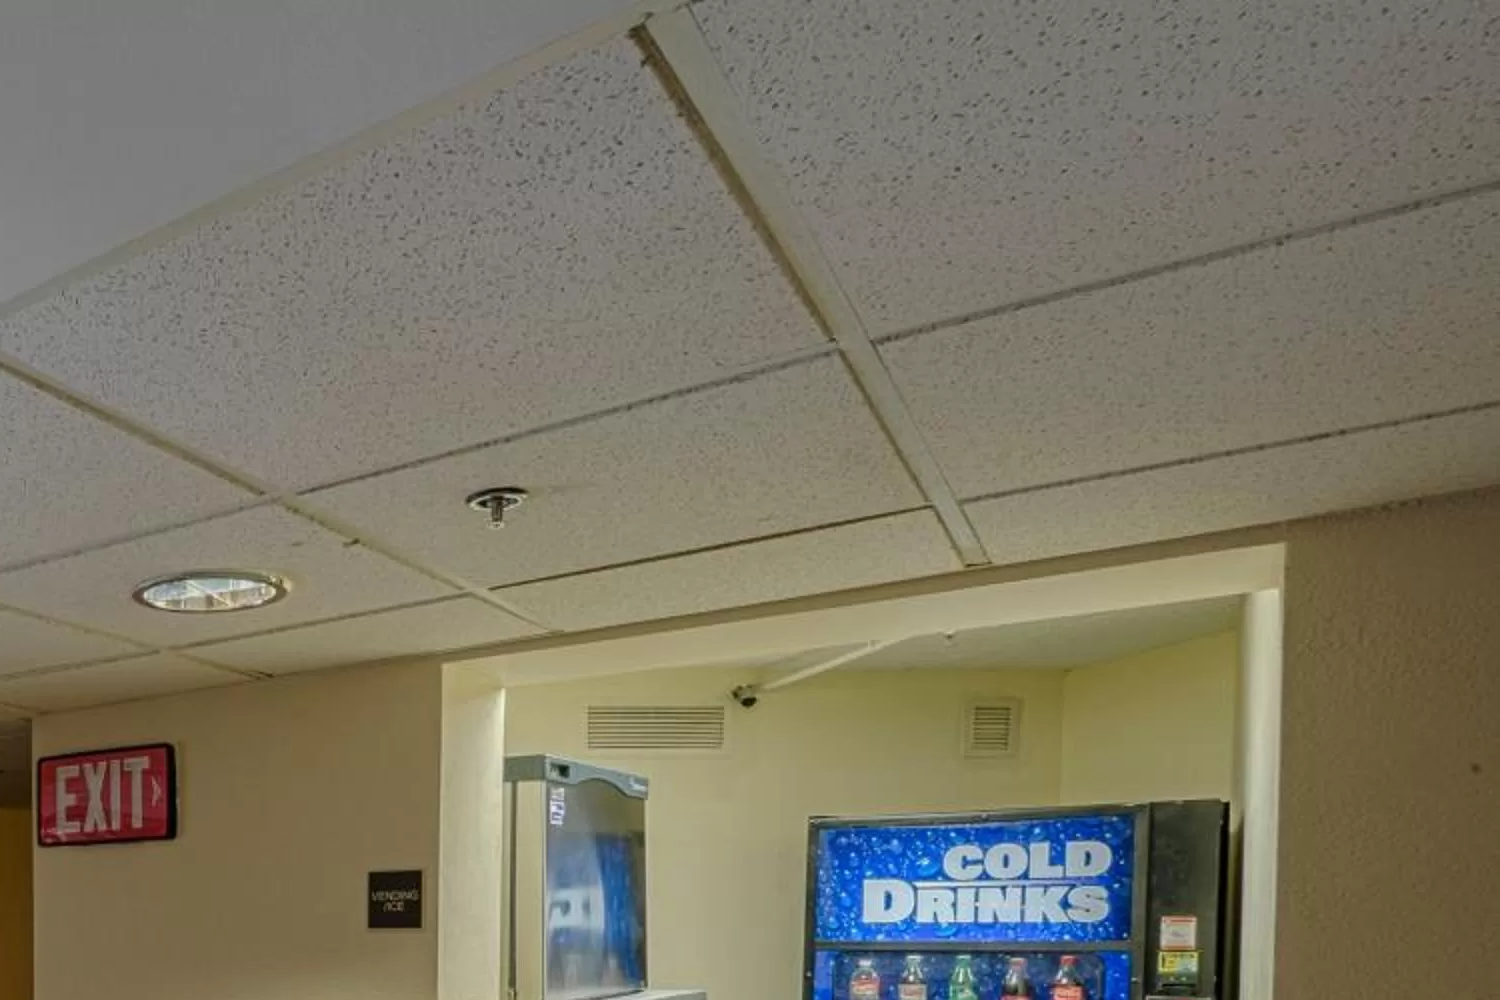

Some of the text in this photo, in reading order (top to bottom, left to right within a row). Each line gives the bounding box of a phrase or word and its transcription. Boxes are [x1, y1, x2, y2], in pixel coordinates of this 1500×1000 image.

[55, 756, 150, 833] EXIT
[943, 841, 1113, 880] COLD
[371, 889, 419, 901] VENDING
[861, 879, 1110, 923] DRINKS
